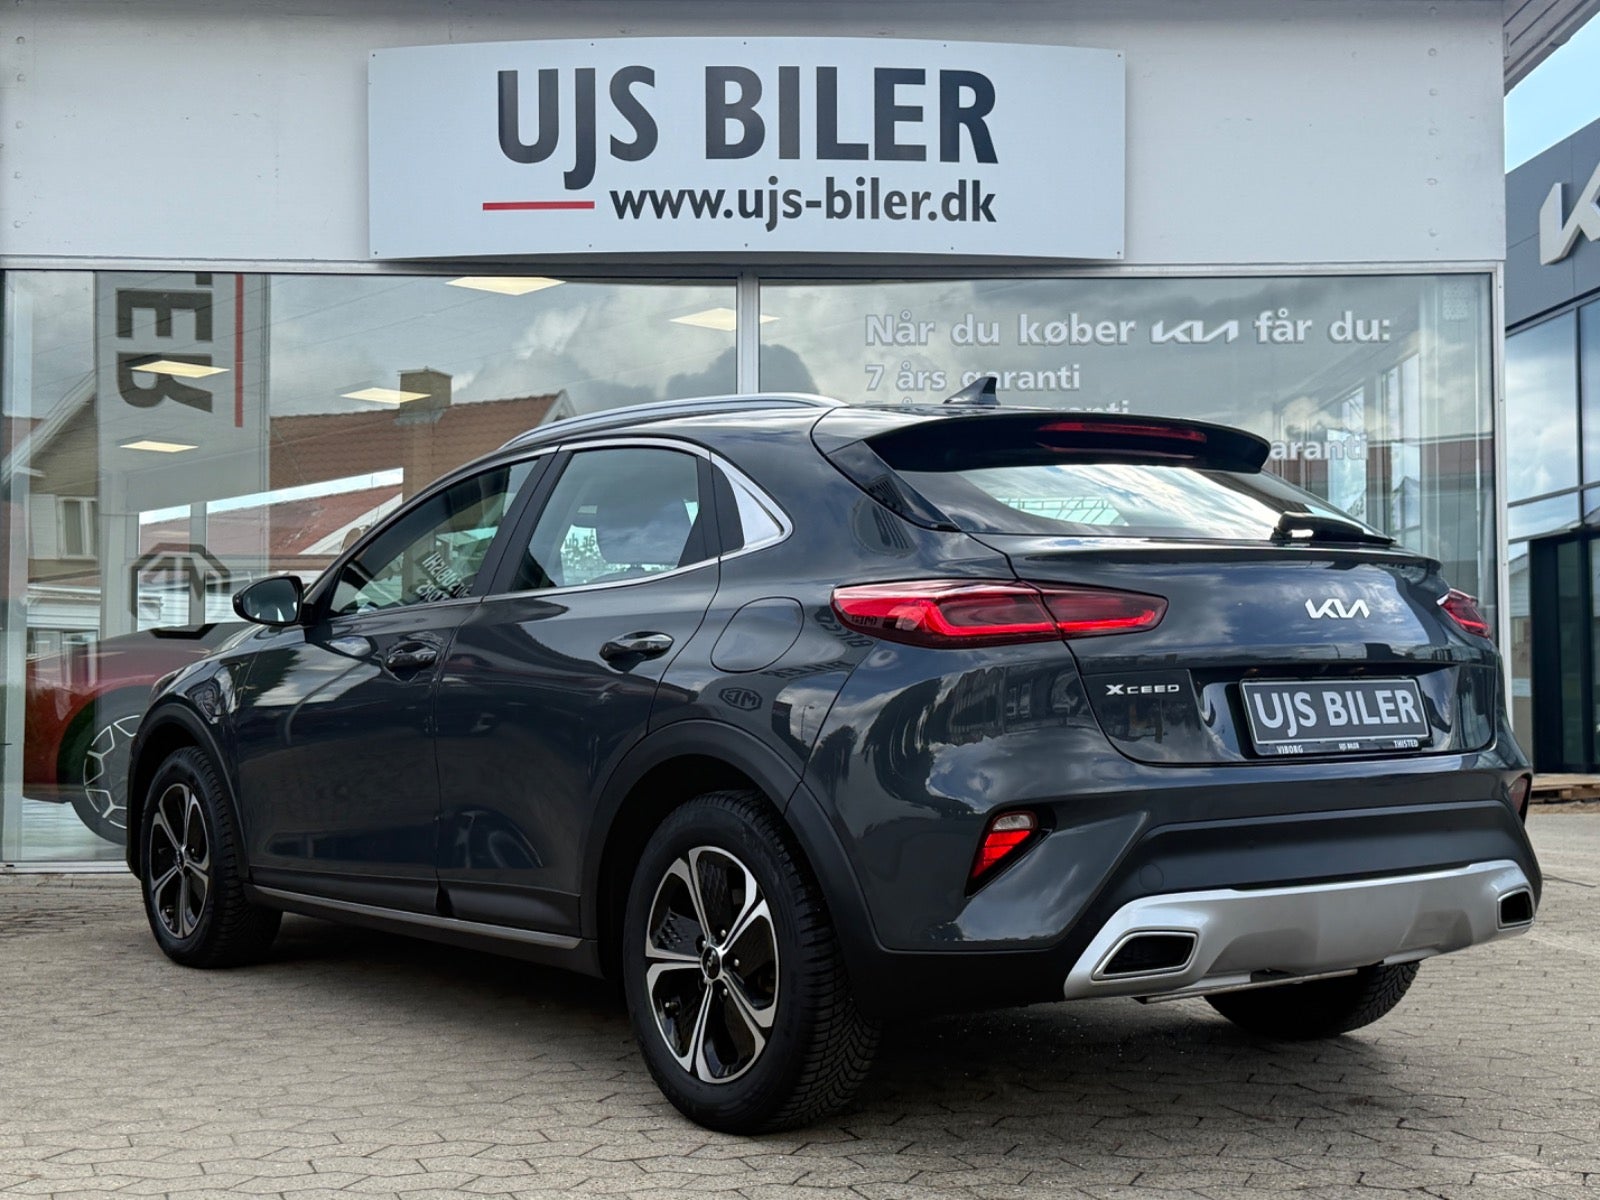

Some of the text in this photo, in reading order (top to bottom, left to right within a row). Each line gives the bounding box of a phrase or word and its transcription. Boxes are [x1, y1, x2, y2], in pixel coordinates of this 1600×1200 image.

[498, 65, 999, 190] UJS BILER
[609, 175, 998, 232] www.ujs-biler.dk
[865, 309, 935, 345] Når
[952, 313, 999, 345] du
[1018, 313, 1136, 345] køber
[1254, 308, 1313, 344] får
[1328, 311, 1392, 343] du:
[865, 365, 884, 391] 7
[897, 361, 946, 391] års
[1269, 434, 1369, 461] aranti
[1253, 690, 1421, 737] UJS BILER
